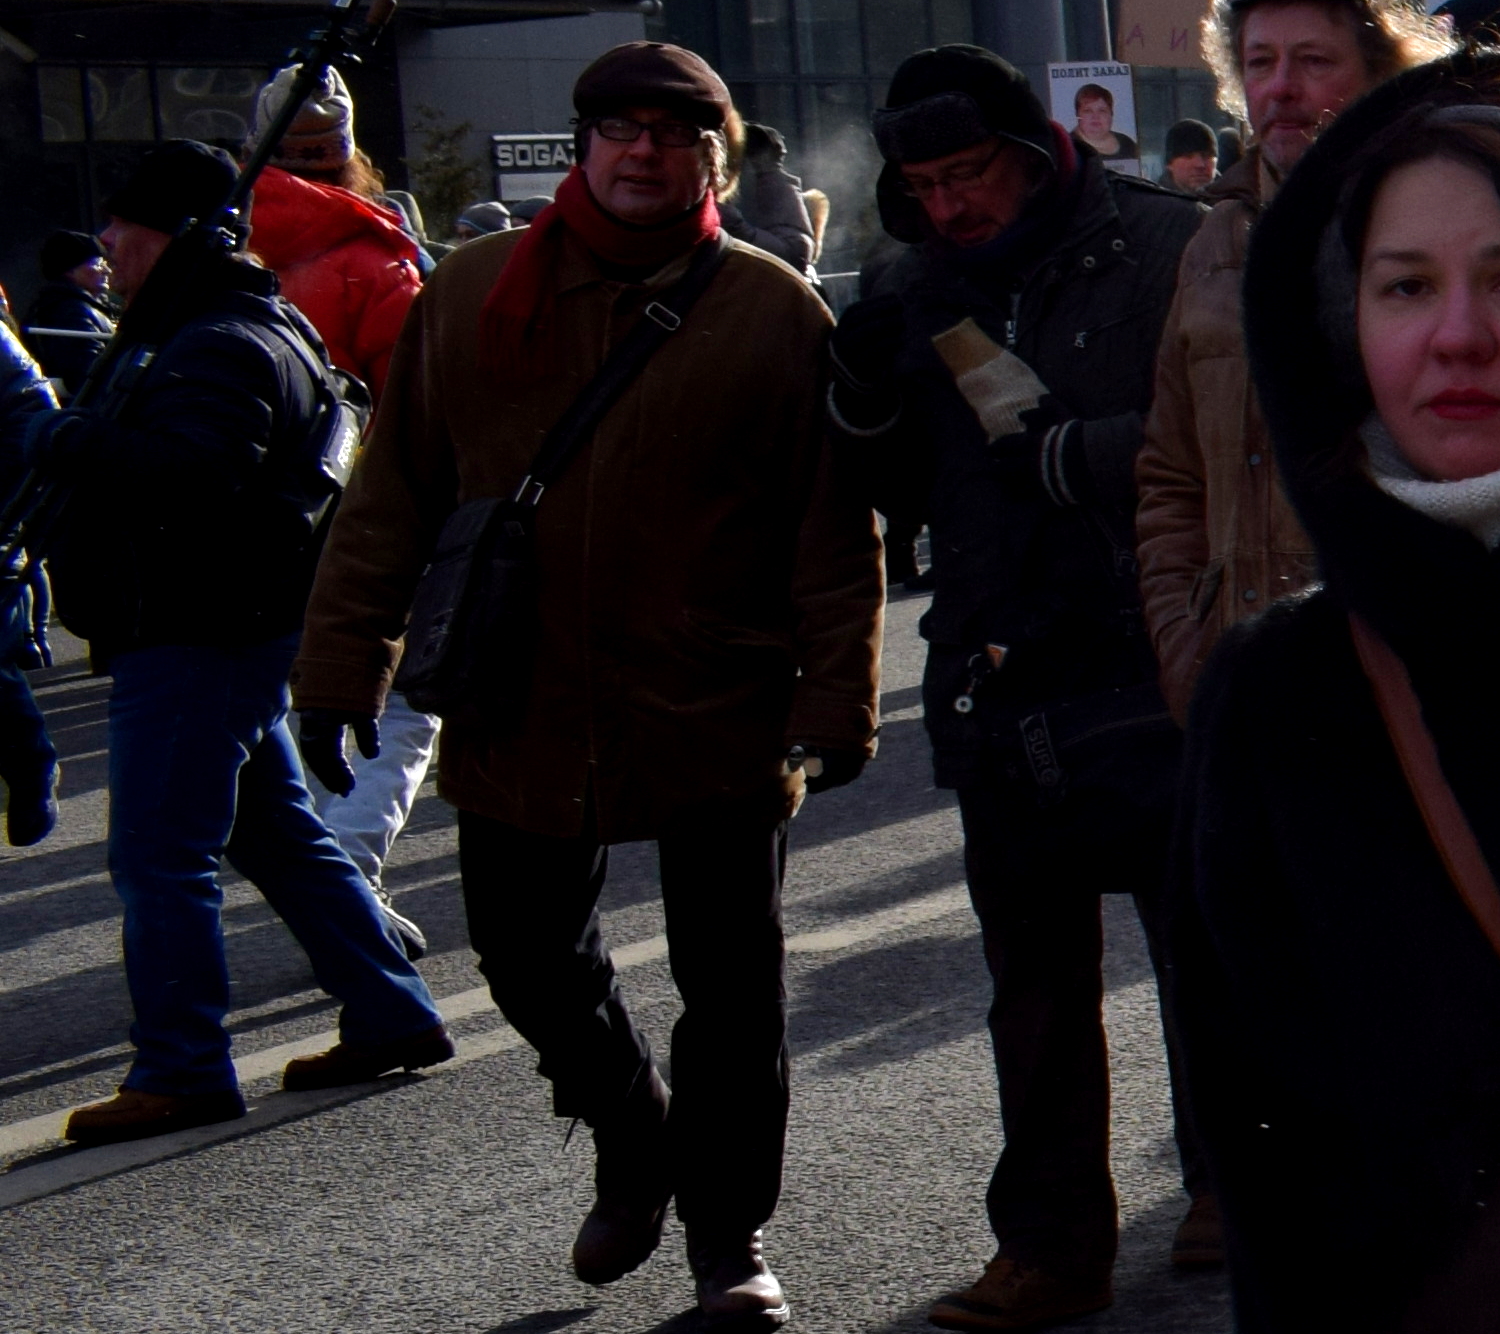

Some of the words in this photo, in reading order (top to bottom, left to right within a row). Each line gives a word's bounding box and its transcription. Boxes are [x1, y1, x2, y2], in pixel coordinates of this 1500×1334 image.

[1126, 25, 1146, 50] А
[1051, 66, 1090, 79] ПОЛИТ
[1093, 65, 1130, 78] ЗАКАЗ
